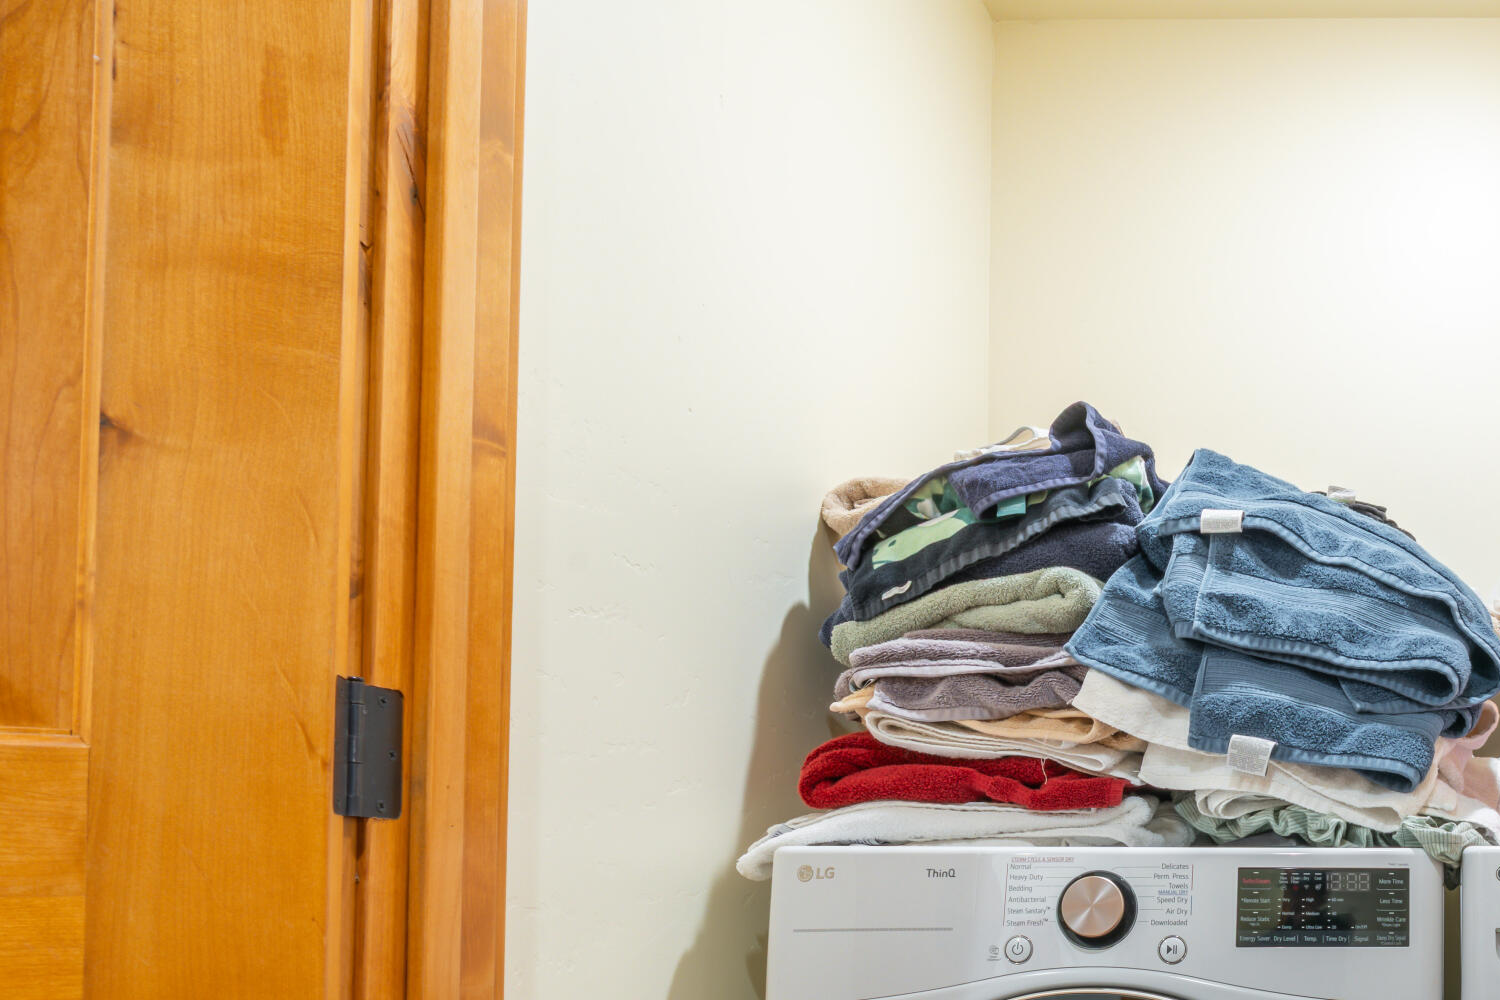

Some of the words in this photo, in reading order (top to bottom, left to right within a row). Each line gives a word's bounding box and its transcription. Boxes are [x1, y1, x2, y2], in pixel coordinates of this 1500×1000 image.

[815, 867, 835, 879] LG
[926, 868, 956, 878] ThinQ
[1008, 885, 1033, 893] Bedding
[1156, 896, 1176, 904] Speed
[1177, 896, 1188, 904] Dry
[1176, 908, 1188, 916] Dry
[1273, 935, 1283, 943] Dry
